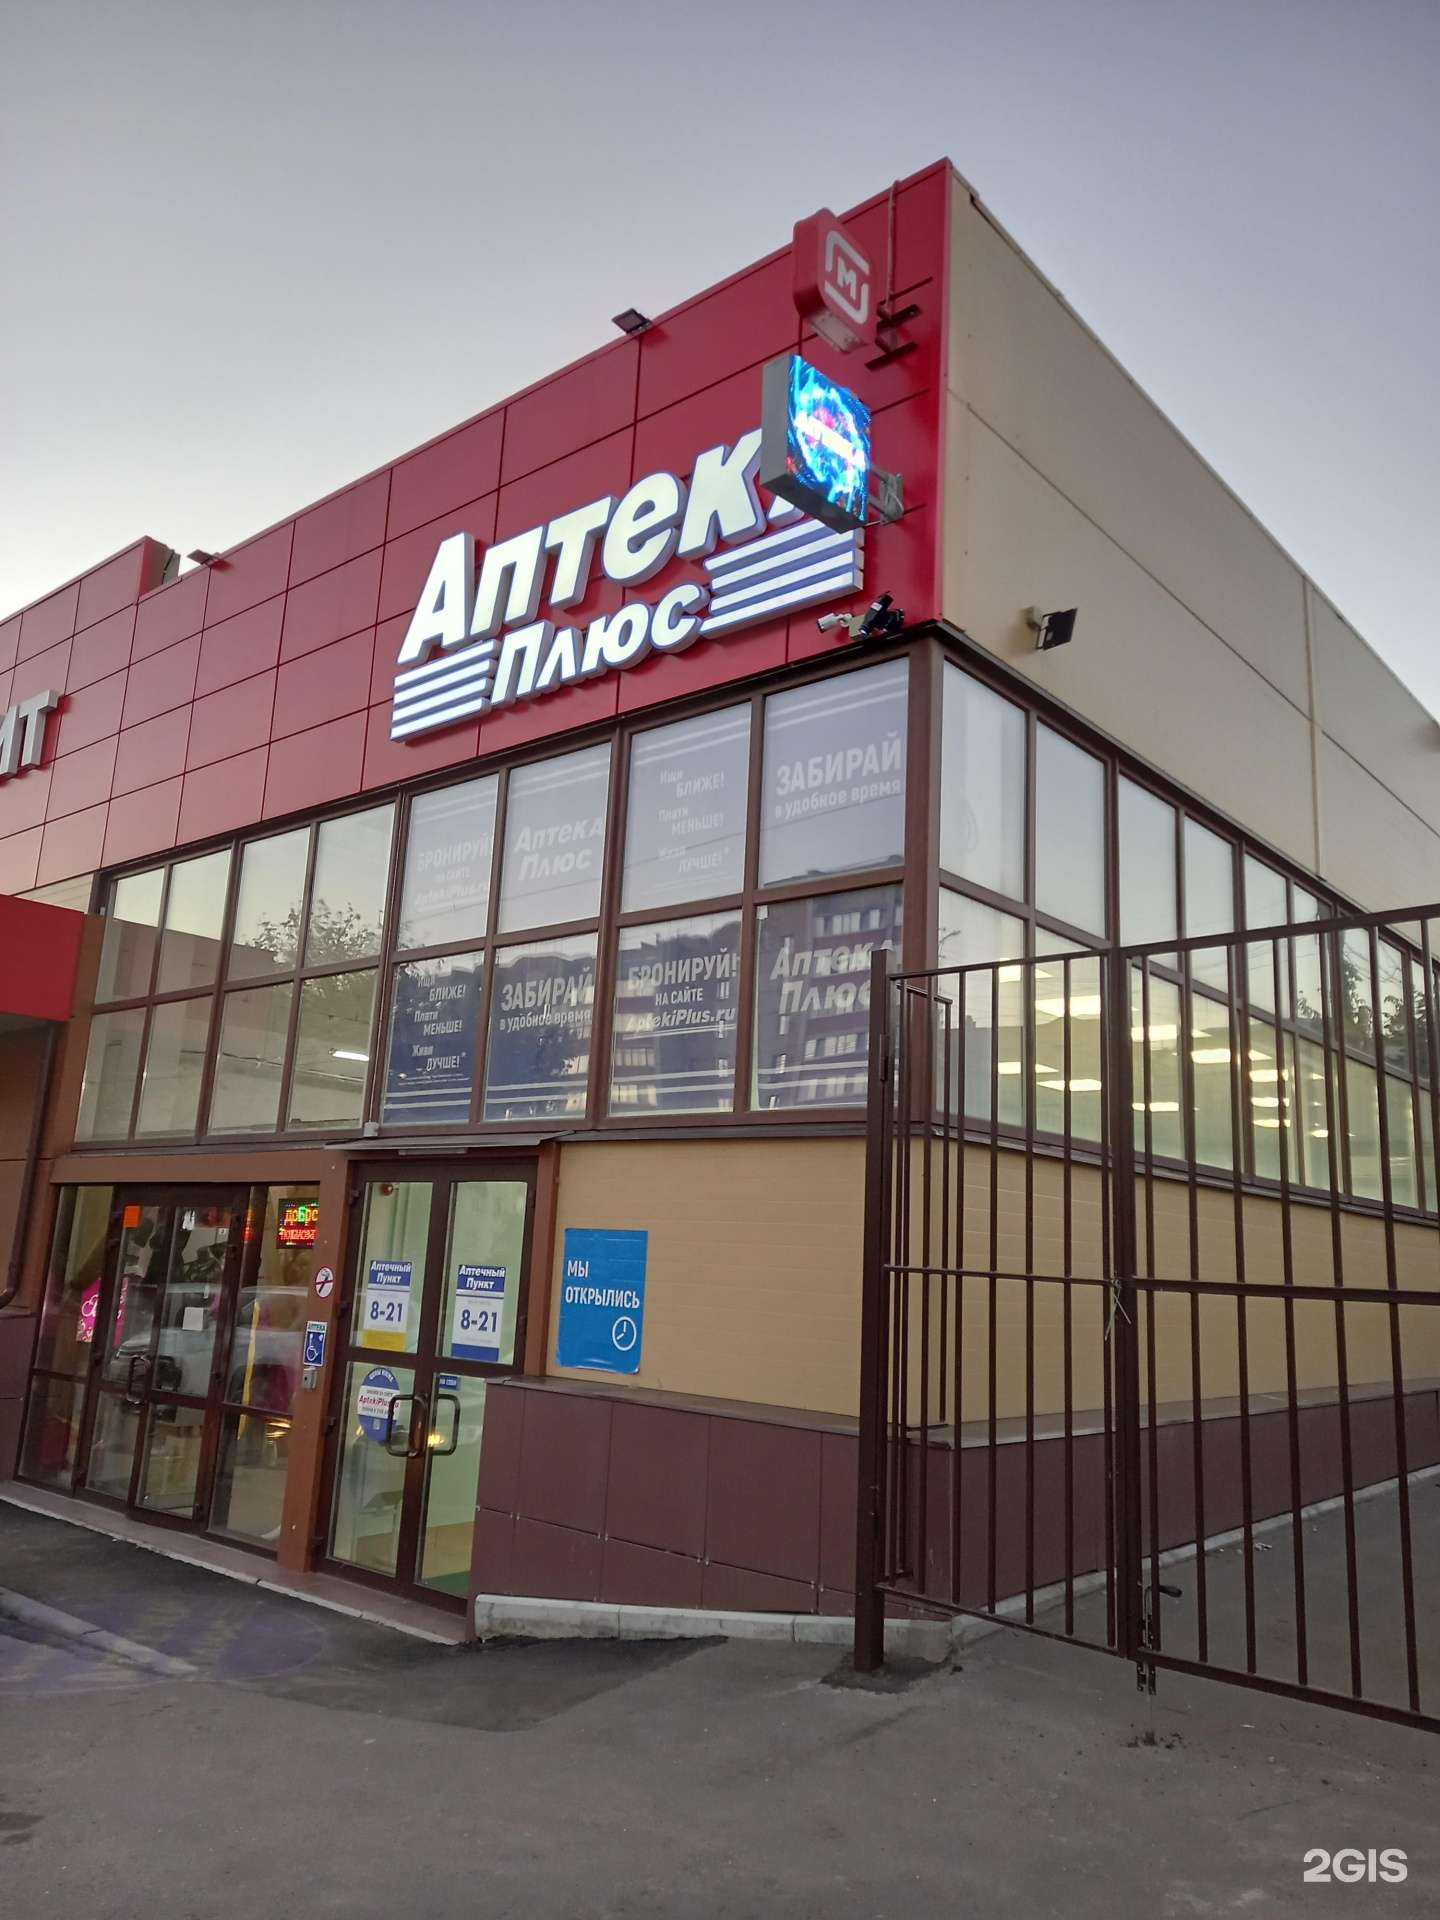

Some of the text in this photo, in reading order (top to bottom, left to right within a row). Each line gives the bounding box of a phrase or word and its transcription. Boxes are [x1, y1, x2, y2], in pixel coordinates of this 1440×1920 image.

[396, 429, 806, 664] Аптек
[775, 731, 901, 796] ЗАБИРАЙ
[675, 772, 725, 799] БЛИЖЕ!
[774, 778, 901, 821] в удобное время
[671, 813, 725, 837] МЕНЬШЕ!
[627, 948, 737, 997] БРОНИРУЙ!
[429, 984, 466, 1002] БЛИЖЕ!
[501, 966, 594, 1012] ЗАБИРАЙ
[655, 985, 703, 1006] НА САЙТЕ
[414, 1010, 438, 1023] Плати
[500, 1009, 593, 1033] в удобное время
[423, 1021, 462, 1036] МЕНЬШЕ!
[371, 1261, 411, 1273] Аптечный
[458, 1265, 505, 1278] Аптечный
[567, 1260, 589, 1278] МЫ
[376, 1273, 402, 1284] Пункт
[466, 1278, 494, 1289] Пункт
[565, 1286, 640, 1308] ОТКРЫЛИСЬ
[370, 1300, 403, 1323] 8-21
[460, 1308, 497, 1333] 8-21
